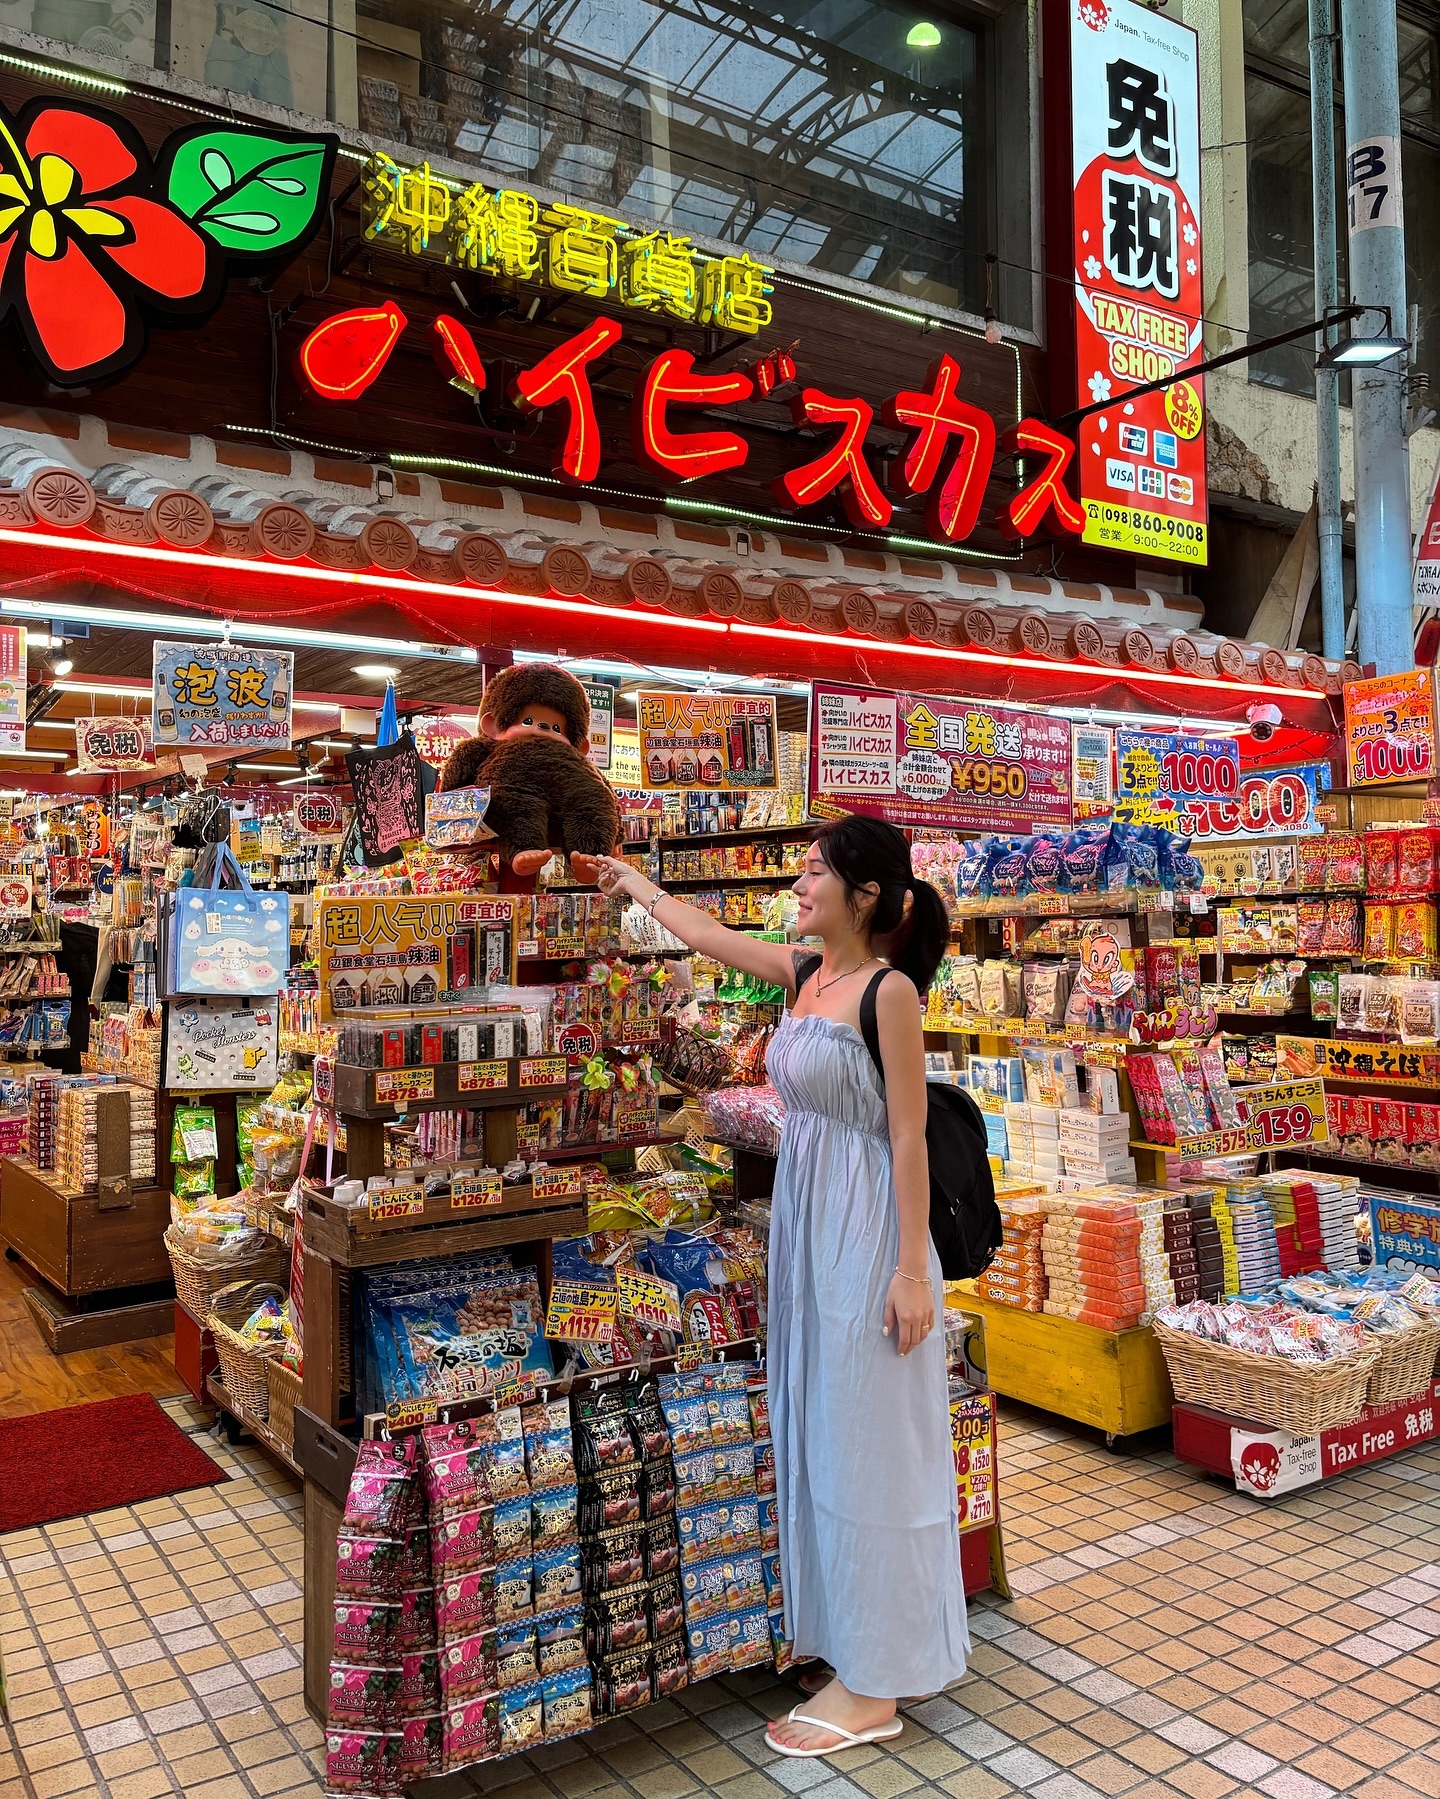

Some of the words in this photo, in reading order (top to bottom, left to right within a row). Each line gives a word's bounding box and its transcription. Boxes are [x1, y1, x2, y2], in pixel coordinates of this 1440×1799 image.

[1115, 19, 1141, 38] Japan.
[1143, 31, 1171, 53] Tax-free
[1172, 46, 1190, 62] Shop
[1104, 57, 1178, 300] 免税
[362, 151, 776, 334] 沖縄百貨店
[1093, 298, 1135, 337] TAX
[1137, 309, 1187, 354] FREE
[1112, 341, 1173, 383] SHOP
[295, 299, 1086, 541] ハイビスカス
[1171, 409, 1197, 437] OFF
[1108, 467, 1134, 484] VISA
[1101, 505, 1204, 542] (098)860-9008
[173, 662, 270, 708] 泡波
[733, 700, 771, 715] 便宜的
[850, 711, 892, 730] ハイビスカス
[1384, 710, 1398, 734] 3
[1399, 715, 1429, 732] 点で!!
[190, 720, 290, 744] 入荷しました!!
[905, 703, 1022, 760] 全国発送
[1352, 722, 1383, 739] よりどり
[88, 732, 138, 756] 免税
[850, 735, 892, 754] ハイビスカス
[1022, 745, 1067, 764] 承ります!!
[1355, 733, 1431, 780] ¥1000
[616, 761, 629, 771] the
[1159, 751, 1237, 795] ¥1000
[823, 768, 891, 786] ハイビスカス
[950, 757, 1027, 800] ¥950
[300, 805, 332, 821] 免税
[460, 901, 512, 921] 便宜的
[546, 950, 575, 958] ¥475
[192, 1024, 227, 1044] Pocket
[212, 1030, 257, 1050] Monsters
[624, 1032, 650, 1041] ¥534
[562, 1036, 592, 1053] 免税
[1328, 1045, 1422, 1078] 沖縄そば
[460, 1077, 495, 1089] ¥878
[520, 1074, 554, 1086] ¥1000
[378, 1088, 419, 1102] ¥878
[1264, 1083, 1316, 1102] ちんすこう
[1215, 1130, 1246, 1154] ¥575
[543, 1173, 574, 1184] 石垣島ラー油
[382, 1191, 422, 1205] にんにく油
[462, 1184, 501, 1194] 石垣島ラー油
[534, 1183, 567, 1197] ¥1347
[452, 1193, 489, 1207] ¥1267
[370, 1203, 409, 1219] ¥1267
[1378, 1234, 1440, 1257] 特典サー
[619, 1275, 663, 1294] オキナワ
[620, 1286, 666, 1307] ビアナッツ
[632, 1302, 668, 1325] ¥1510
[560, 1315, 600, 1340] ¥1137
[433, 1330, 527, 1373] 石垣の塩
[679, 1350, 701, 1360] ナッツ
[454, 1360, 522, 1394] 島ナッツ
[495, 1384, 522, 1400] 島ナッツ
[496, 1392, 525, 1410] ¥400
[400, 1401, 437, 1413] べにいもナッツ
[387, 1412, 425, 1429] ¥400
[954, 1417, 988, 1439] 100コ
[1404, 1407, 1434, 1440] 免税
[1287, 1448, 1317, 1465] Tax-free
[1327, 1442, 1358, 1466] Tax
[1362, 1431, 1395, 1456] Free
[1299, 1461, 1317, 1476] Shop
